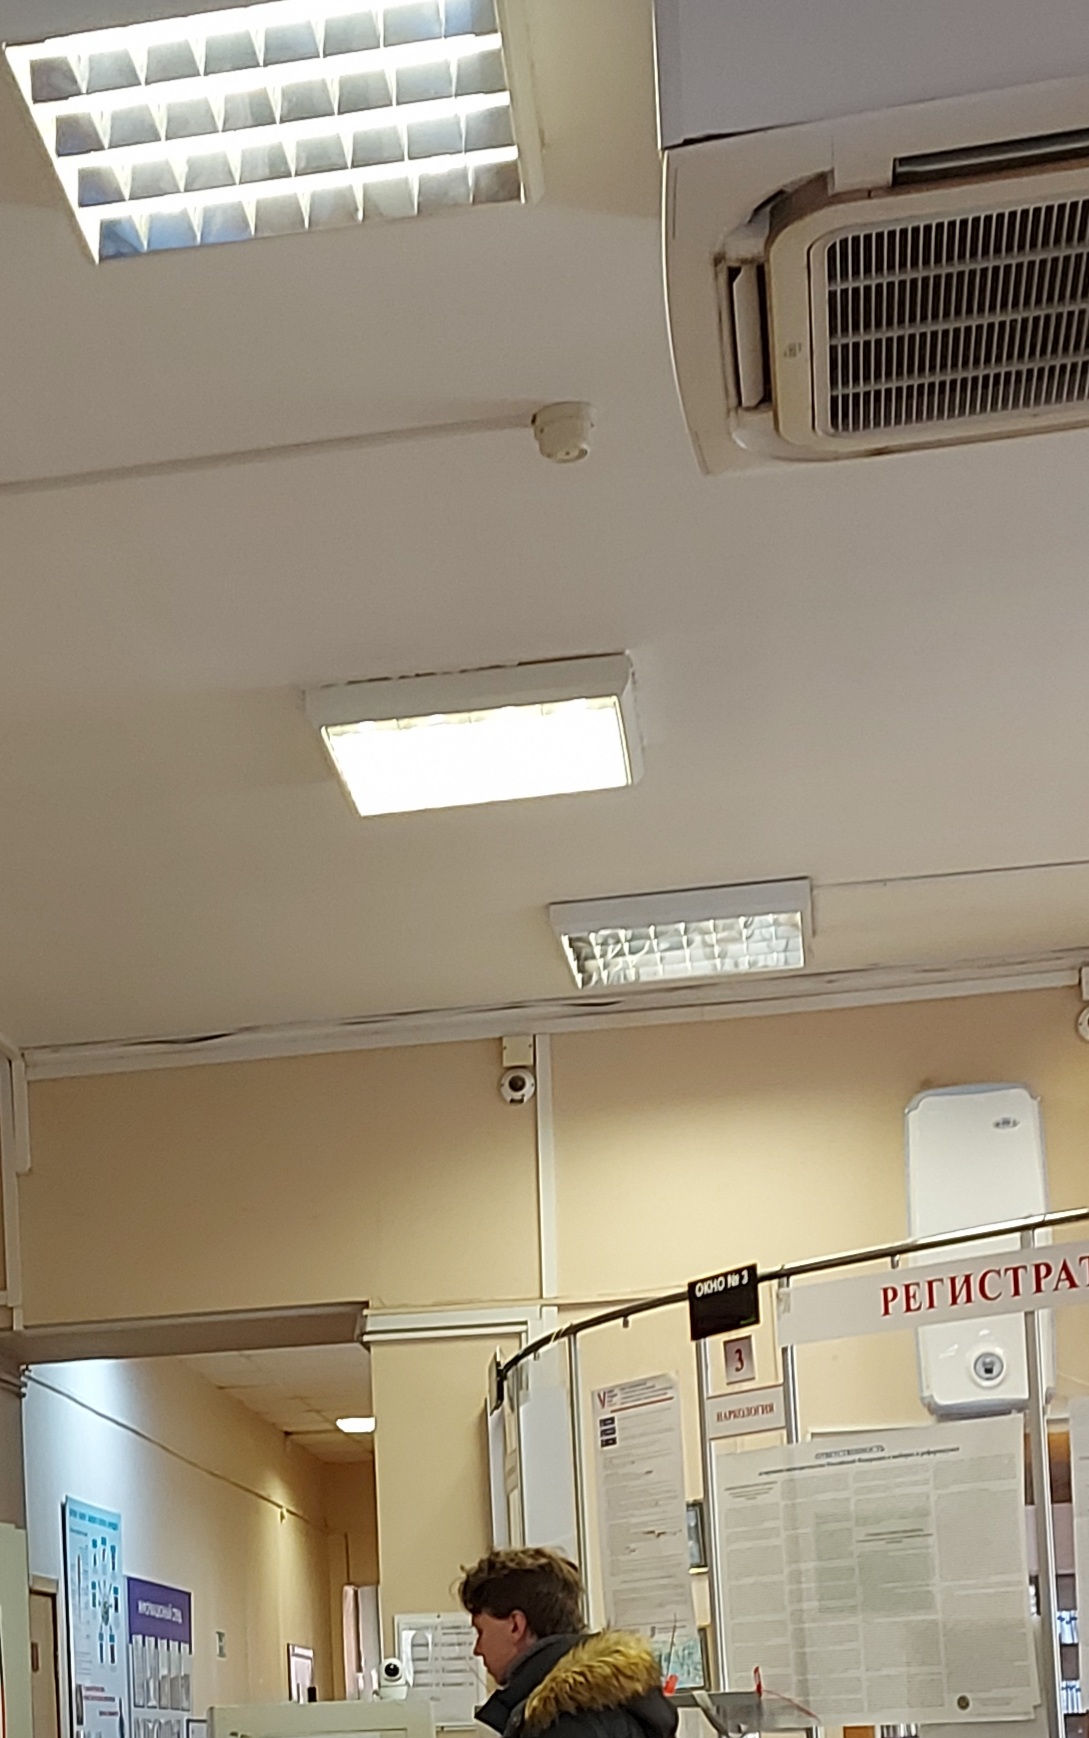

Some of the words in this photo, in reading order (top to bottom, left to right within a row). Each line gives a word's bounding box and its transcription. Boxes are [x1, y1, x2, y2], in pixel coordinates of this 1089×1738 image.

[695, 1276, 725, 1298] ОКНО
[741, 1269, 749, 1285] 3
[734, 1348, 745, 1372] 3
[716, 1403, 774, 1422] НАРКОЛОГИЯ
